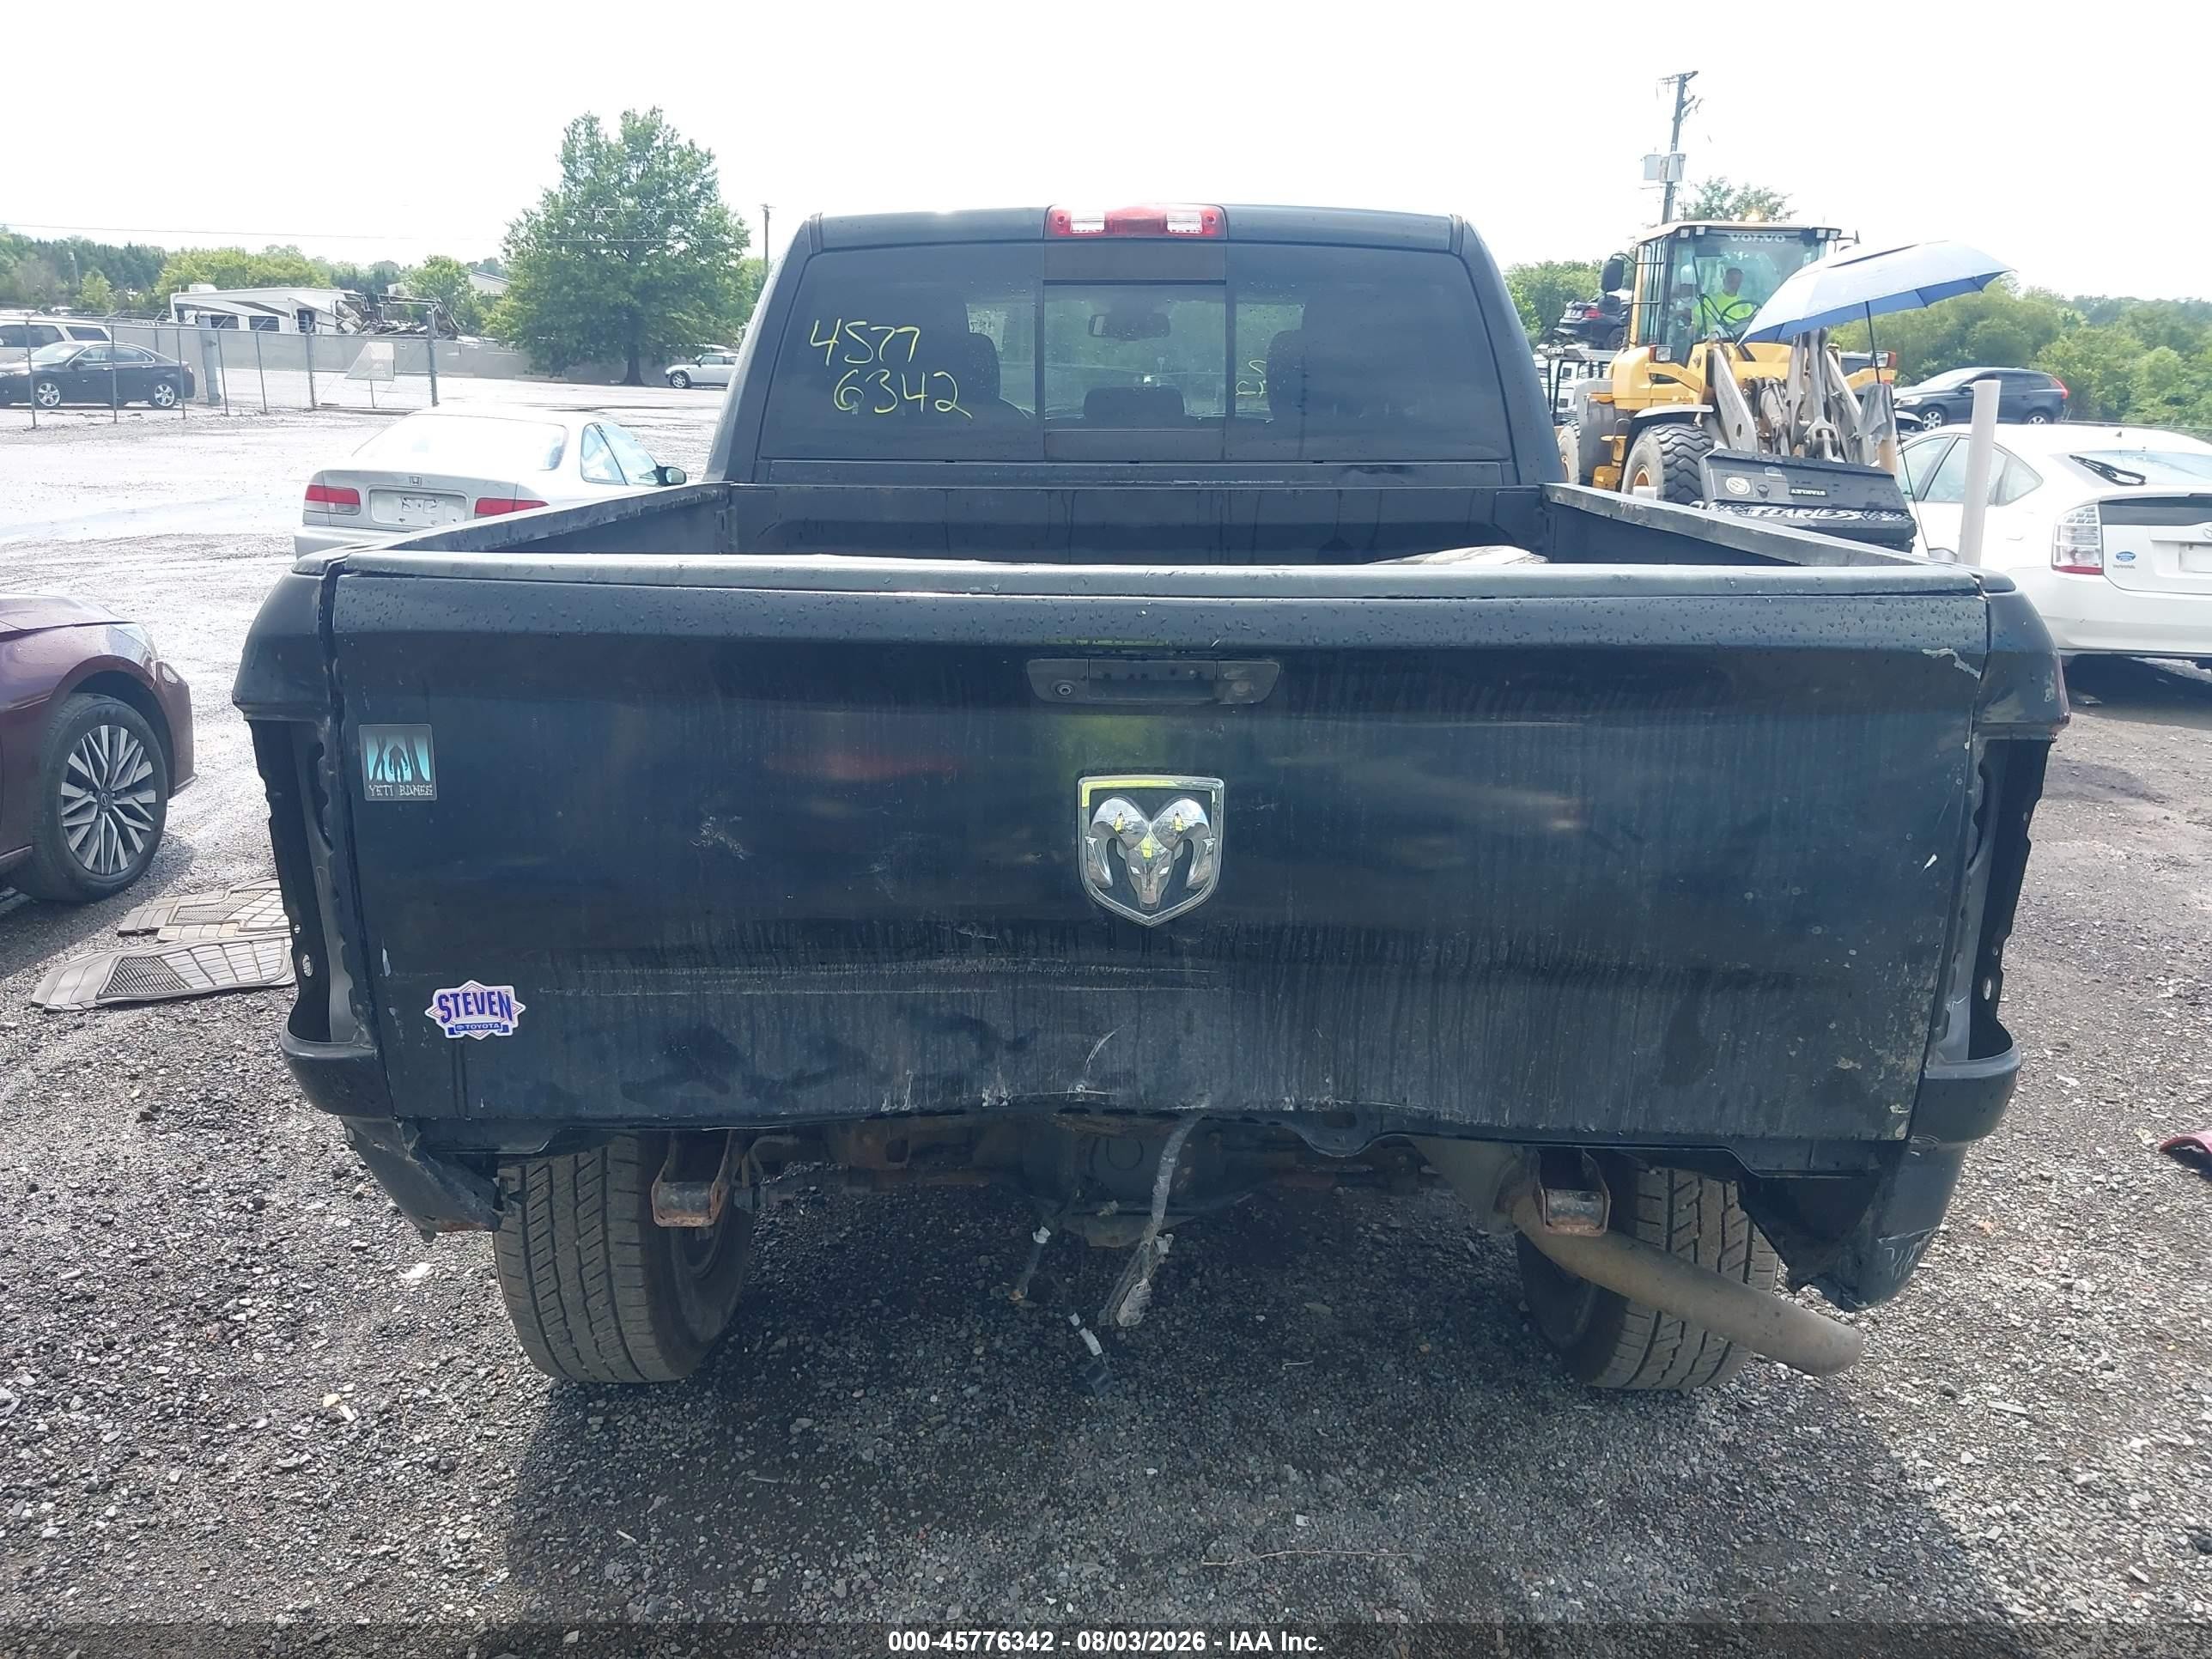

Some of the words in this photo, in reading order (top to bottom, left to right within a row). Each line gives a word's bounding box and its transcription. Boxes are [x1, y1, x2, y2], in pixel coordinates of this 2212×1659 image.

[1726, 233, 1786, 243] VOLVO
[810, 319, 921, 367] 4577
[834, 369, 973, 419] 6342
[369, 784, 394, 797] YETI
[437, 990, 513, 1024] STEVEN
